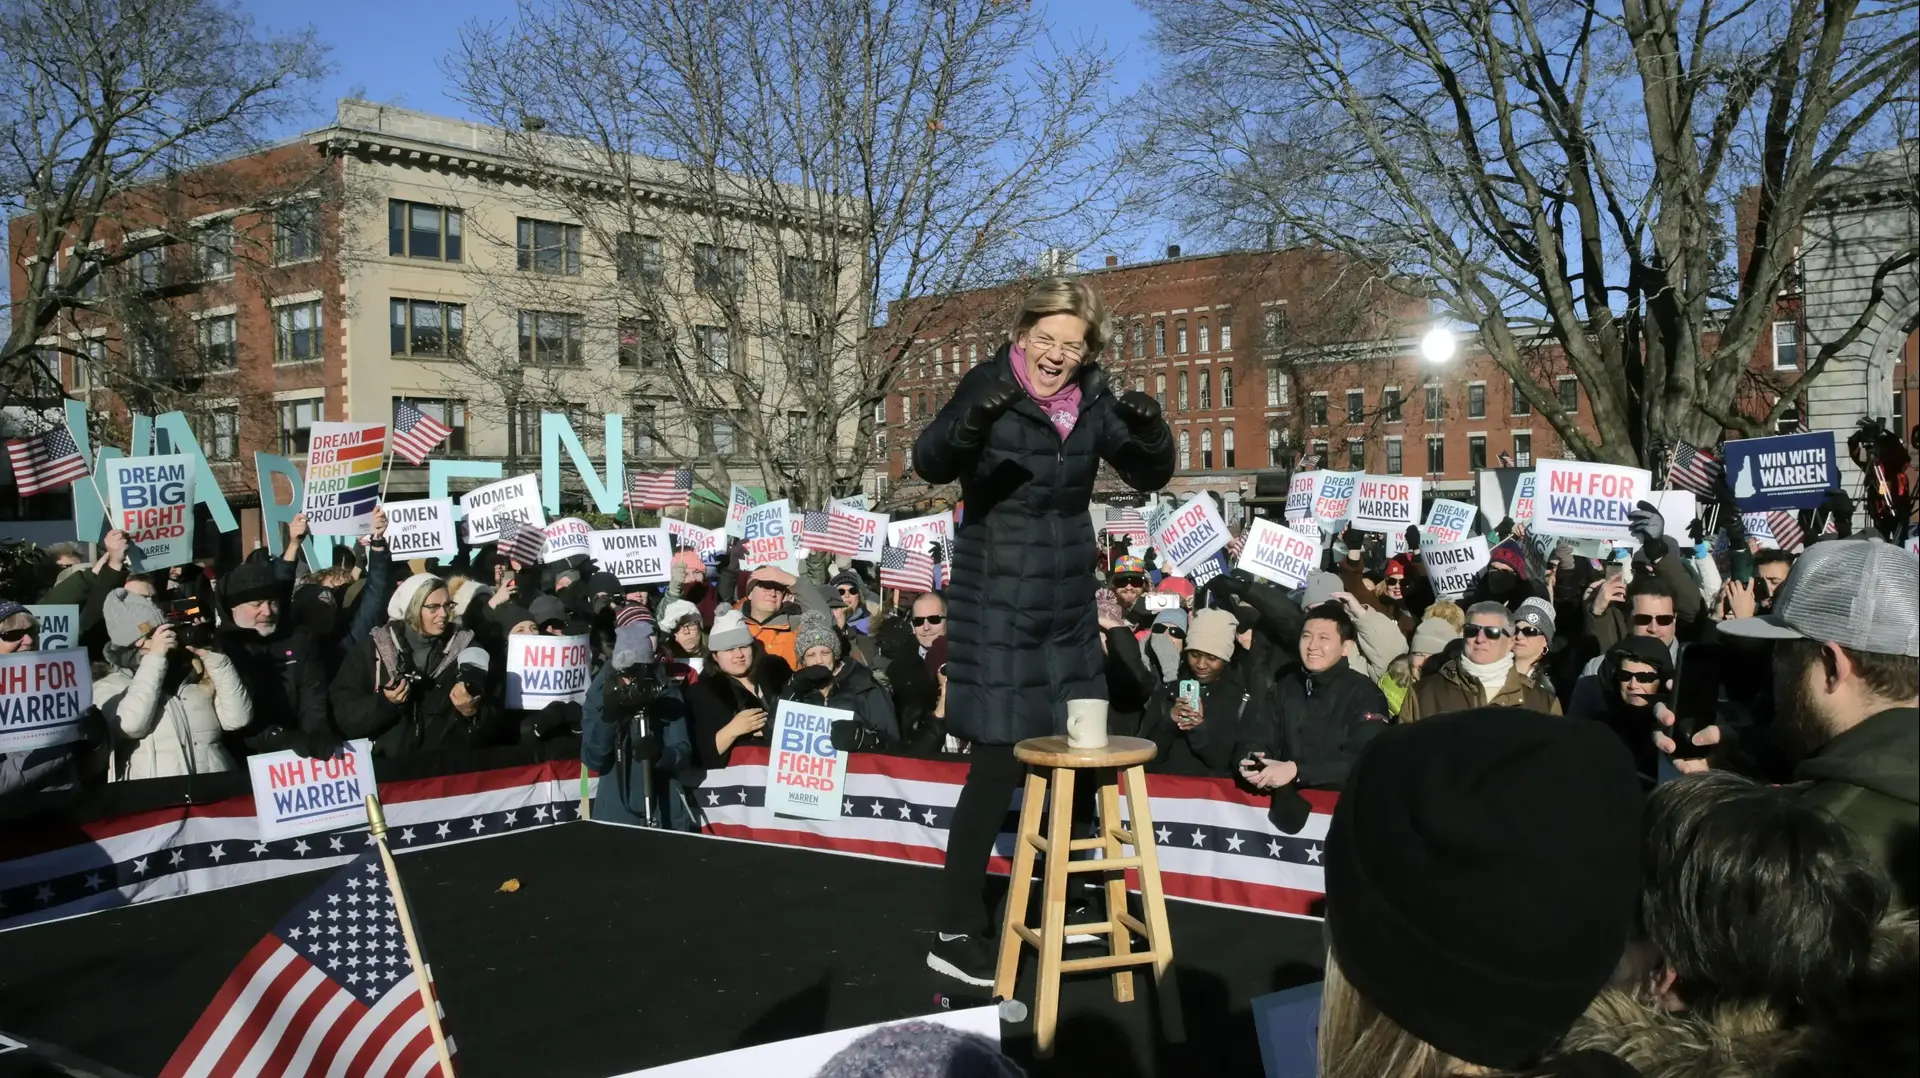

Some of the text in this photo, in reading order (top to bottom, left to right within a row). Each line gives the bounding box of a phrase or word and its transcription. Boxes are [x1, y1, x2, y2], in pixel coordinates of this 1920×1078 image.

[314, 431, 360, 450] DREAM
[312, 450, 334, 464] BIG
[1759, 448, 1826, 467] WIN WITH
[119, 464, 184, 484] DREAM
[310, 462, 349, 480] FIGHT
[1760, 464, 1828, 486] WARREN
[308, 478, 346, 495] HARD
[1295, 478, 1313, 492] FOR
[1320, 485, 1353, 499] BIG
[1360, 482, 1376, 499] NH
[1380, 484, 1409, 500] FOR
[1550, 470, 1582, 494] NH
[1589, 473, 1634, 499] FOR
[121, 482, 185, 509] BIG
[307, 494, 336, 509] LIVE
[469, 484, 524, 509] WOMEN
[1287, 493, 1312, 508] ARREN
[1316, 497, 1350, 511] FIGHT
[306, 506, 351, 523] PROUD
[492, 503, 506, 512] WITH
[746, 507, 781, 525] DREAM
[1315, 507, 1346, 518] HARD
[1359, 499, 1409, 518] WARREN
[1436, 504, 1470, 519] DREAM
[1550, 495, 1632, 521] WARREN
[123, 504, 186, 531] FIGHT
[472, 507, 530, 533] WARREN
[848, 516, 876, 534] OR
[1161, 524, 1179, 548] NH
[1177, 504, 1206, 534] FOR
[1431, 514, 1464, 531] BIG
[1744, 516, 1772, 534] ARRE
[124, 525, 185, 543] HARD
[402, 524, 417, 532] WITH
[545, 525, 566, 538] NH
[669, 523, 703, 541] NH FO
[745, 520, 784, 540] BIG
[922, 520, 946, 534] OR
[1428, 525, 1461, 543] FIGHT
[550, 534, 589, 549] WARRE
[602, 534, 657, 550] WOMEN
[902, 534, 925, 549] OR
[1168, 520, 1215, 562] WARREN
[1259, 527, 1314, 561] NH FOR
[746, 551, 788, 565] HARD
[1256, 544, 1310, 577] WARREN
[1425, 546, 1475, 565] WOMEN
[605, 557, 662, 576] WARREN
[1195, 558, 1220, 575] WITH
[1195, 568, 1223, 586] RREN
[1431, 572, 1479, 591] WARREN
[524, 645, 586, 667] NH FOR
[35, 661, 77, 692] FOR
[524, 667, 586, 690] WARREN
[781, 728, 837, 758] BIG
[268, 752, 357, 789] NH FOR
[779, 751, 836, 778] FIGHT
[777, 772, 834, 792] HARD
[273, 778, 361, 815] WARREN
[788, 792, 818, 803] WARREN
